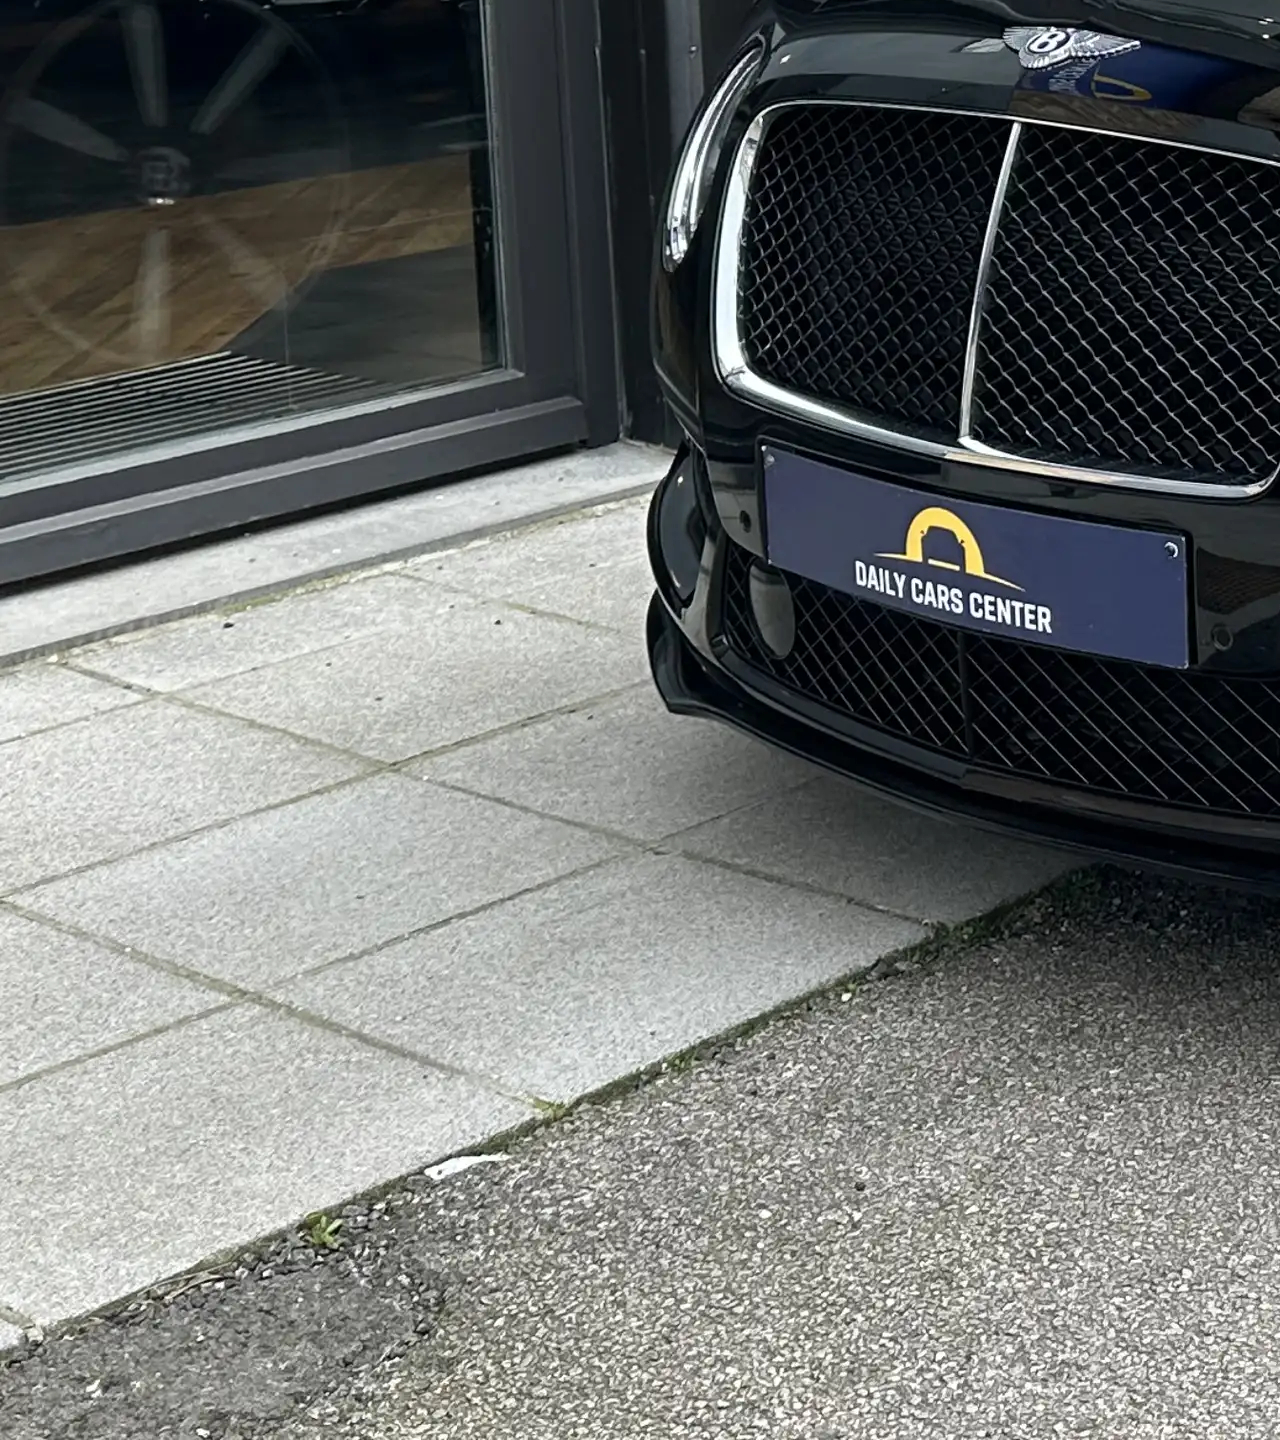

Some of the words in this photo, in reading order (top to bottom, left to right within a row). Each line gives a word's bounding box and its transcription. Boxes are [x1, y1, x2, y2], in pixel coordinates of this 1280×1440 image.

[854, 559, 907, 600] DAILY
[910, 576, 965, 616] CARS
[968, 591, 1054, 635] CENTER
